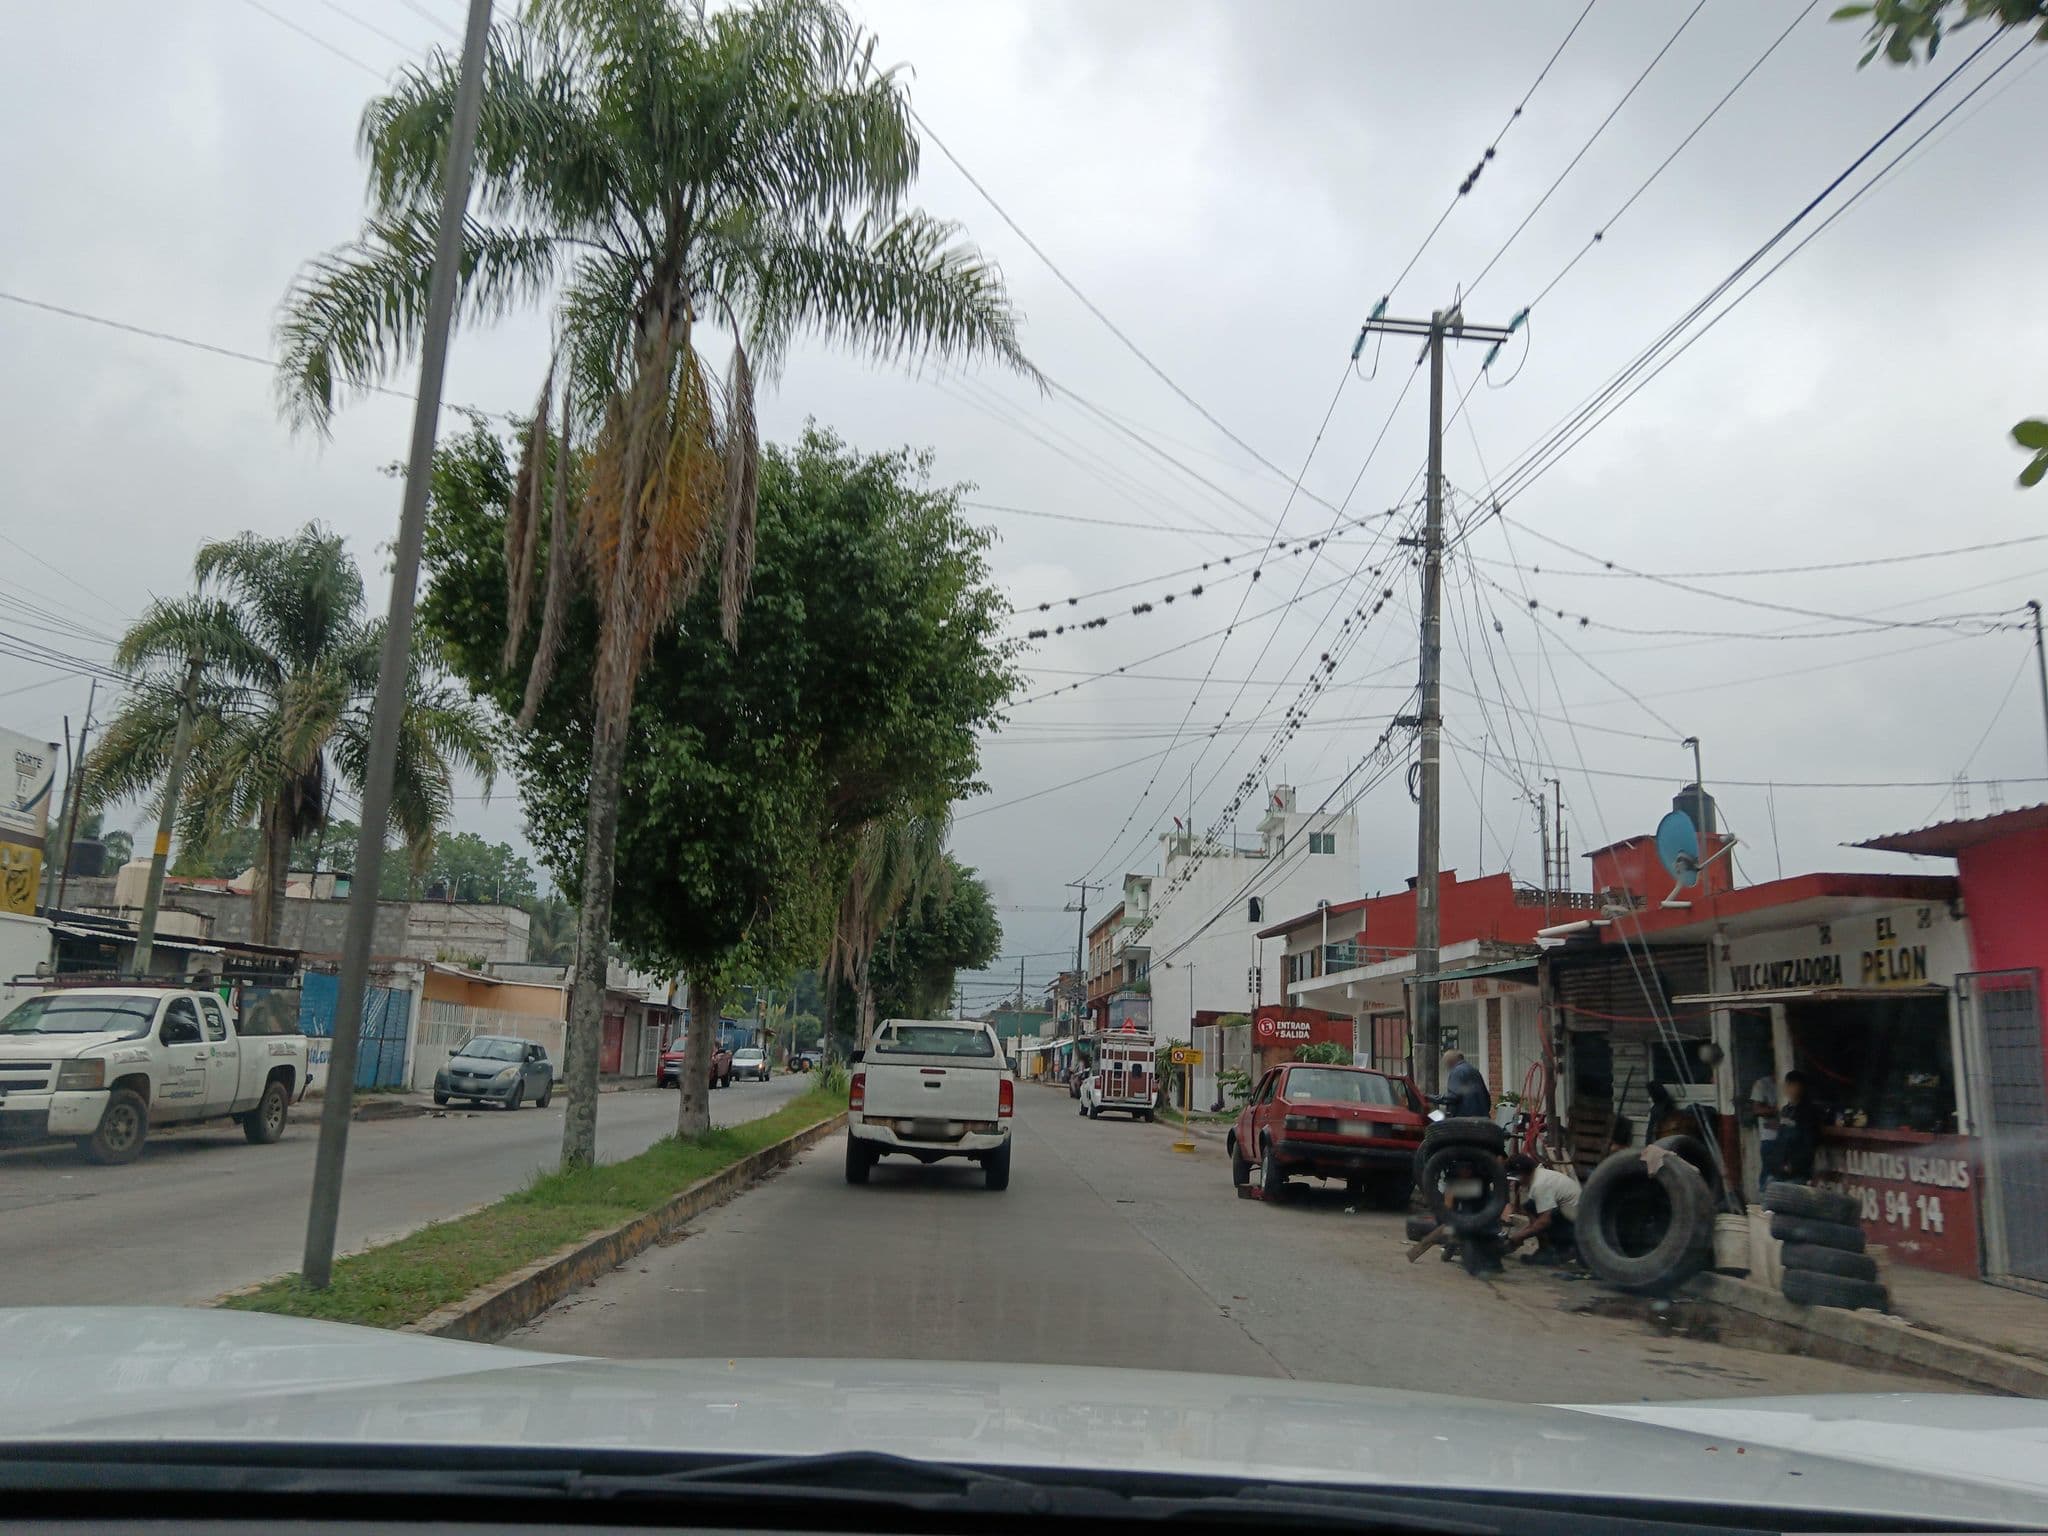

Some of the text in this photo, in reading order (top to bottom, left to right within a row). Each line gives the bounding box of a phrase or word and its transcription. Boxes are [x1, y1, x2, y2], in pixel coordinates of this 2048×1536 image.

[15, 751, 44, 769] CORTE
[1875, 917, 1897, 941] EL
[1730, 944, 1928, 992] VULCANIZADORA PELON
[1276, 1020, 1311, 1031] ENTRADA
[1280, 1029, 1310, 1039] SALIDA
[1908, 1155, 1970, 1189] USADAS
[1884, 1189, 1912, 1230] 94
[1916, 1194, 1945, 1233] 14
